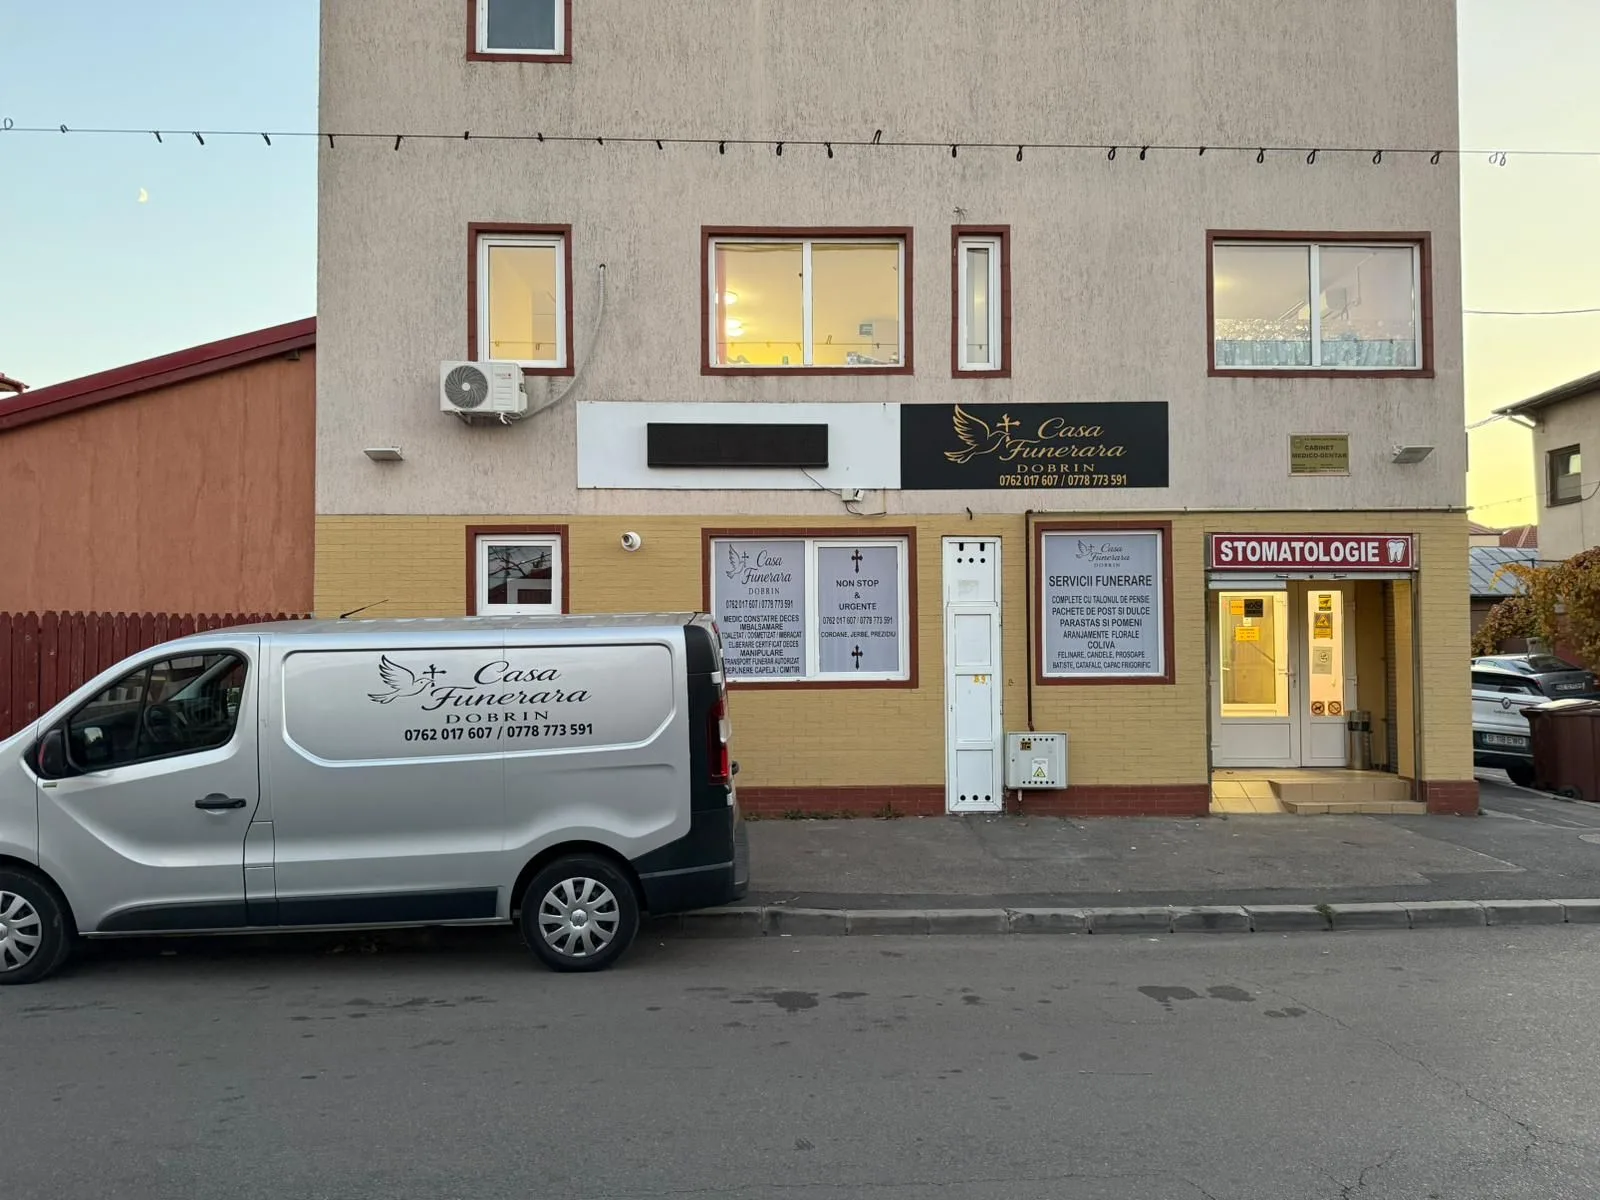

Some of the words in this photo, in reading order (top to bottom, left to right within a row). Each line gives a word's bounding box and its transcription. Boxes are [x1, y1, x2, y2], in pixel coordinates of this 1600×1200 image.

[1038, 417, 1105, 439] Casa
[1000, 439, 1127, 461] Funerara
[1018, 464, 1095, 473] DOBRIN
[1000, 475, 1021, 486] 0762
[1024, 475, 1039, 486] 017
[1042, 475, 1058, 486] 607
[1068, 474, 1090, 486] 0778
[1092, 474, 1108, 485] 773
[1110, 474, 1127, 485] 591
[1100, 543, 1123, 553] Casa
[1220, 541, 1380, 562] STOMATOLOGIE
[757, 550, 782, 567] Casa
[1088, 552, 1130, 561] Funerara
[742, 568, 792, 584] Funerara
[1049, 576, 1092, 587] SERVICII
[1096, 575, 1152, 586] FUNERARE
[1126, 607, 1150, 615] DULCE
[474, 661, 562, 684] Casa
[421, 686, 592, 710] Funerara
[446, 711, 548, 724] DOBRIN
[405, 729, 437, 741] 0762
[441, 728, 463, 740] 017
[468, 727, 492, 739] 607
[507, 726, 539, 737] 0778
[543, 724, 566, 736] 773
[570, 724, 593, 735] 591
